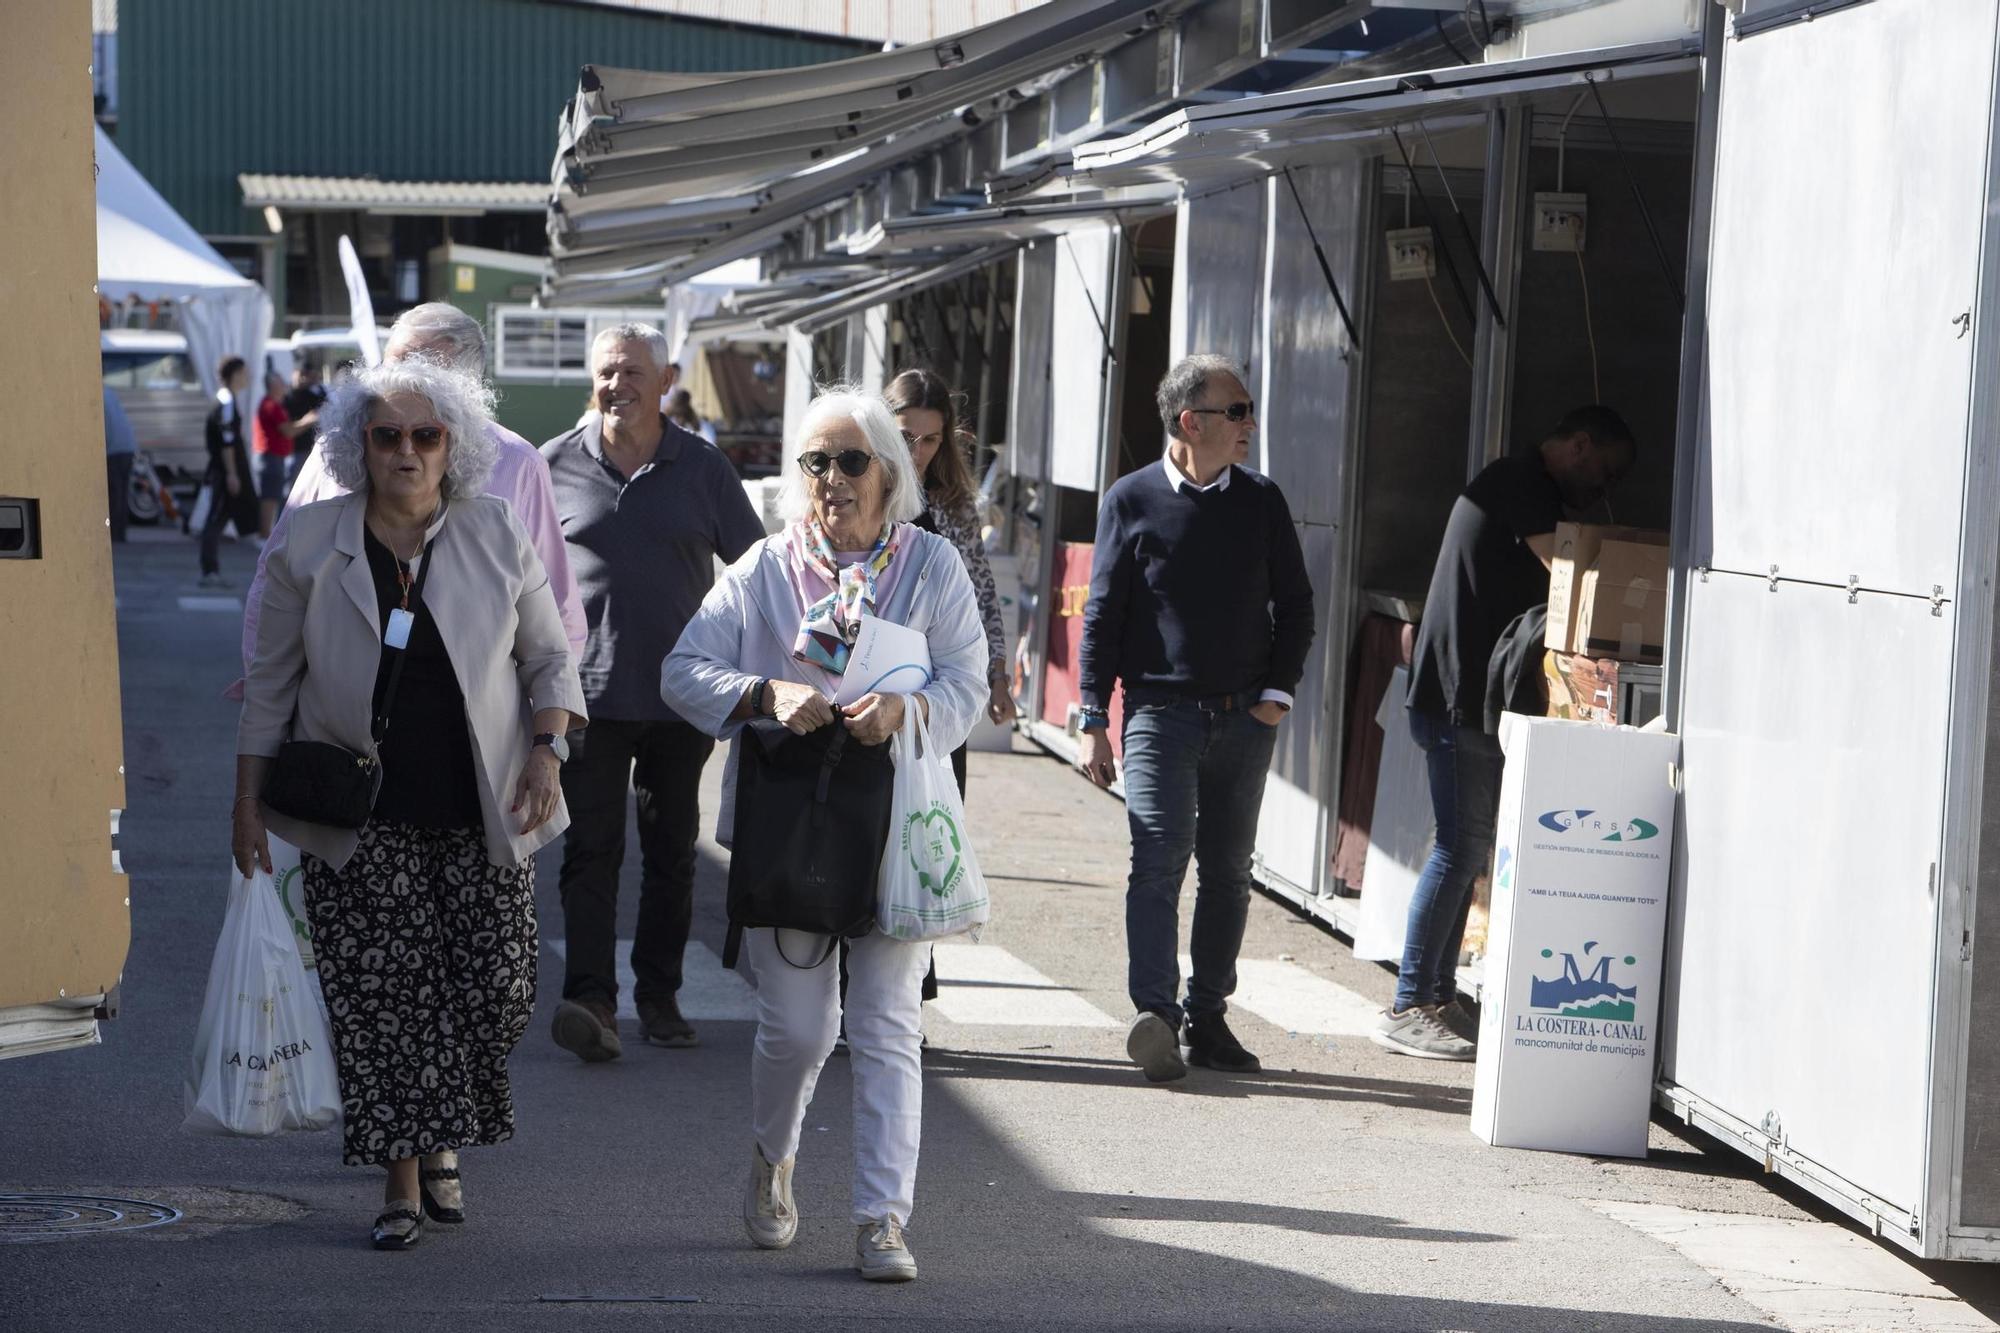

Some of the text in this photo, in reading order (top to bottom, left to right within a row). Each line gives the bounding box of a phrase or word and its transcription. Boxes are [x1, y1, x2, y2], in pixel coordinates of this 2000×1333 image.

[1559, 846, 1586, 854] INTEGRAL
[1596, 849, 1624, 857] RESIDUOS
[1548, 889, 1557, 897] LA
[1559, 890, 1577, 898] TEUA
[1577, 892, 1600, 900] AJUDA
[1602, 894, 1636, 903] GUANYEM
[1516, 1015, 1533, 1032] LA
[1603, 1022, 1647, 1041] CANAL
[1515, 1037, 1646, 1058] mancomunitat de municipis
